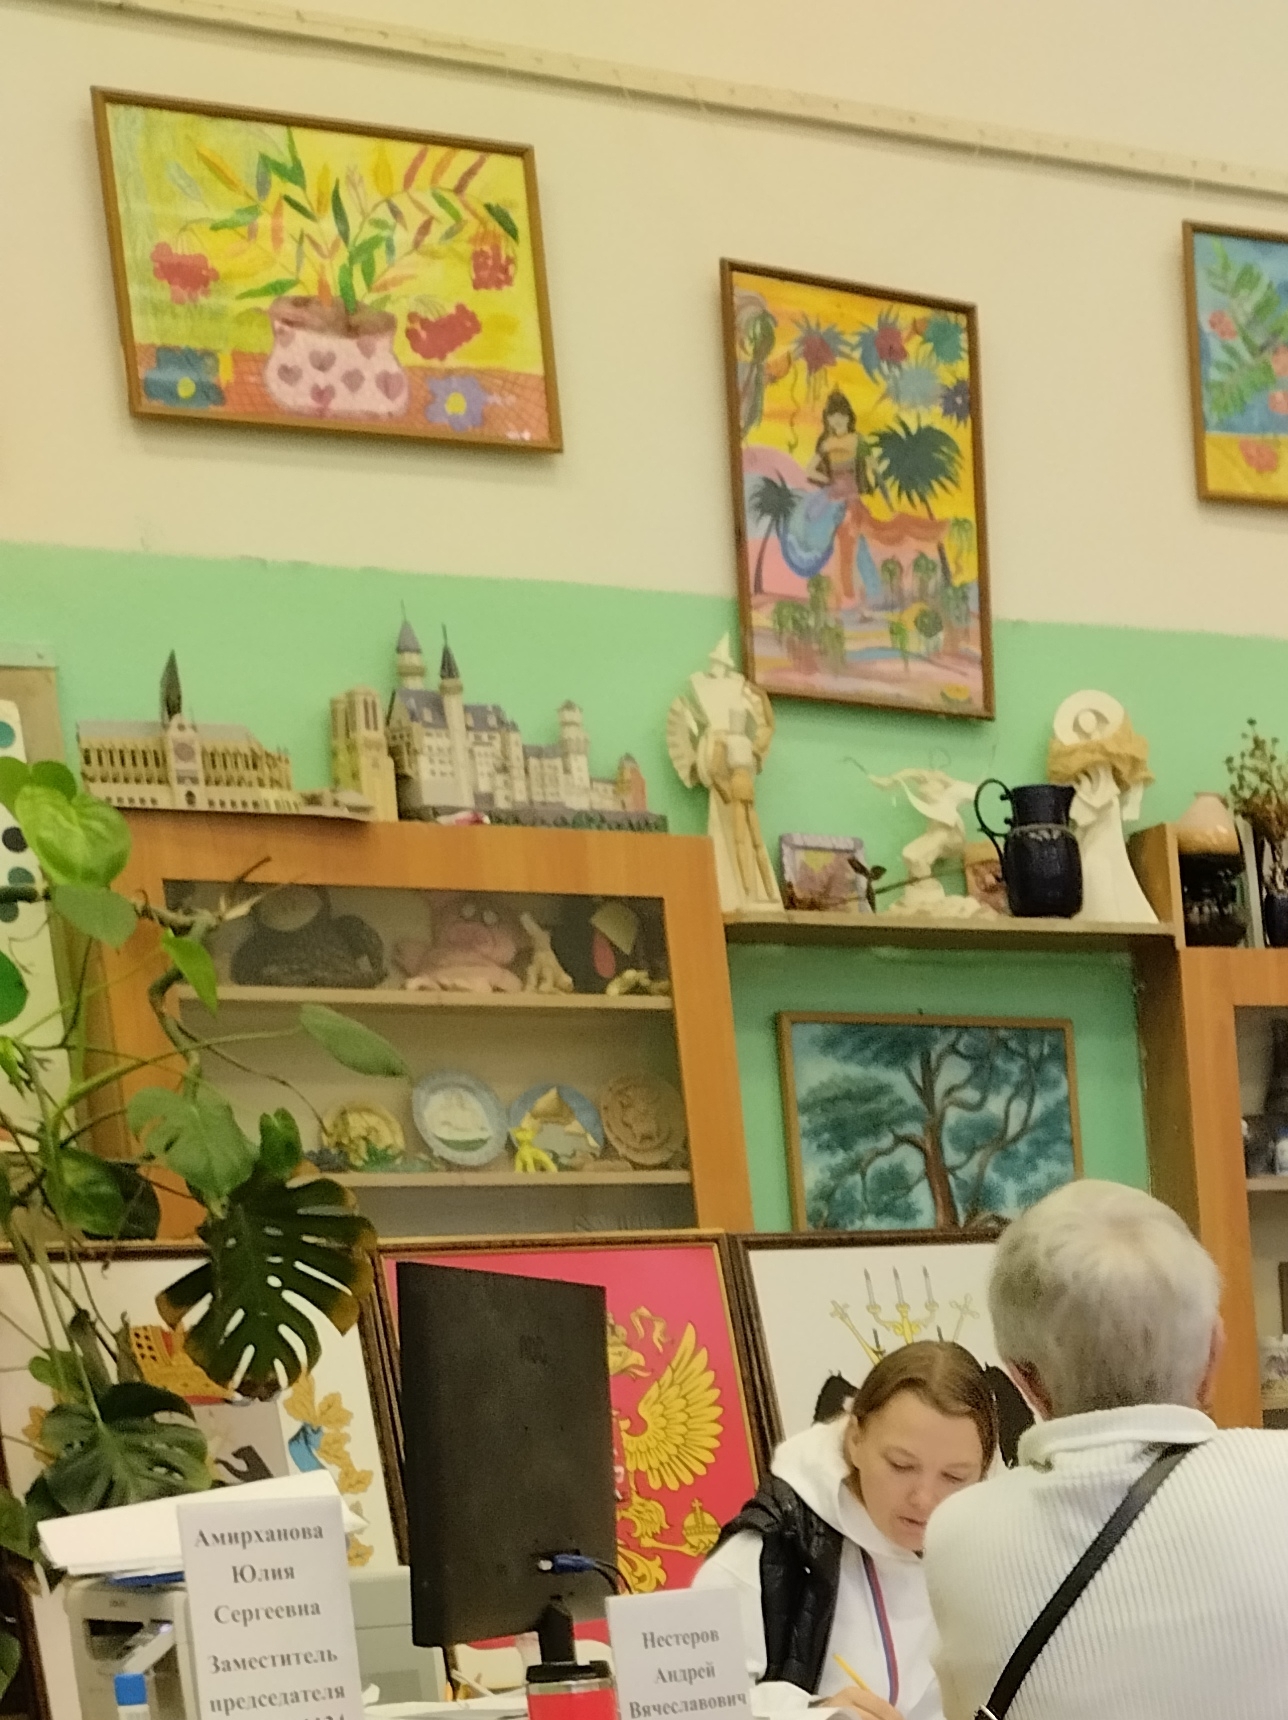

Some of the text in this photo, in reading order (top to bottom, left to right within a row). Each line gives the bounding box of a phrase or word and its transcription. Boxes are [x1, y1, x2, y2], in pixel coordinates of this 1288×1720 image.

[195, 1525, 324, 1550] Амирханова
[231, 1564, 295, 1583] Юлия
[214, 1602, 321, 1627] Сергеевна
[642, 1629, 720, 1650] Нестеров
[208, 1649, 338, 1674] Заместитель
[655, 1661, 716, 1685] Андрей
[210, 1685, 346, 1716] председателя
[629, 1693, 747, 1719] Вячеславович
